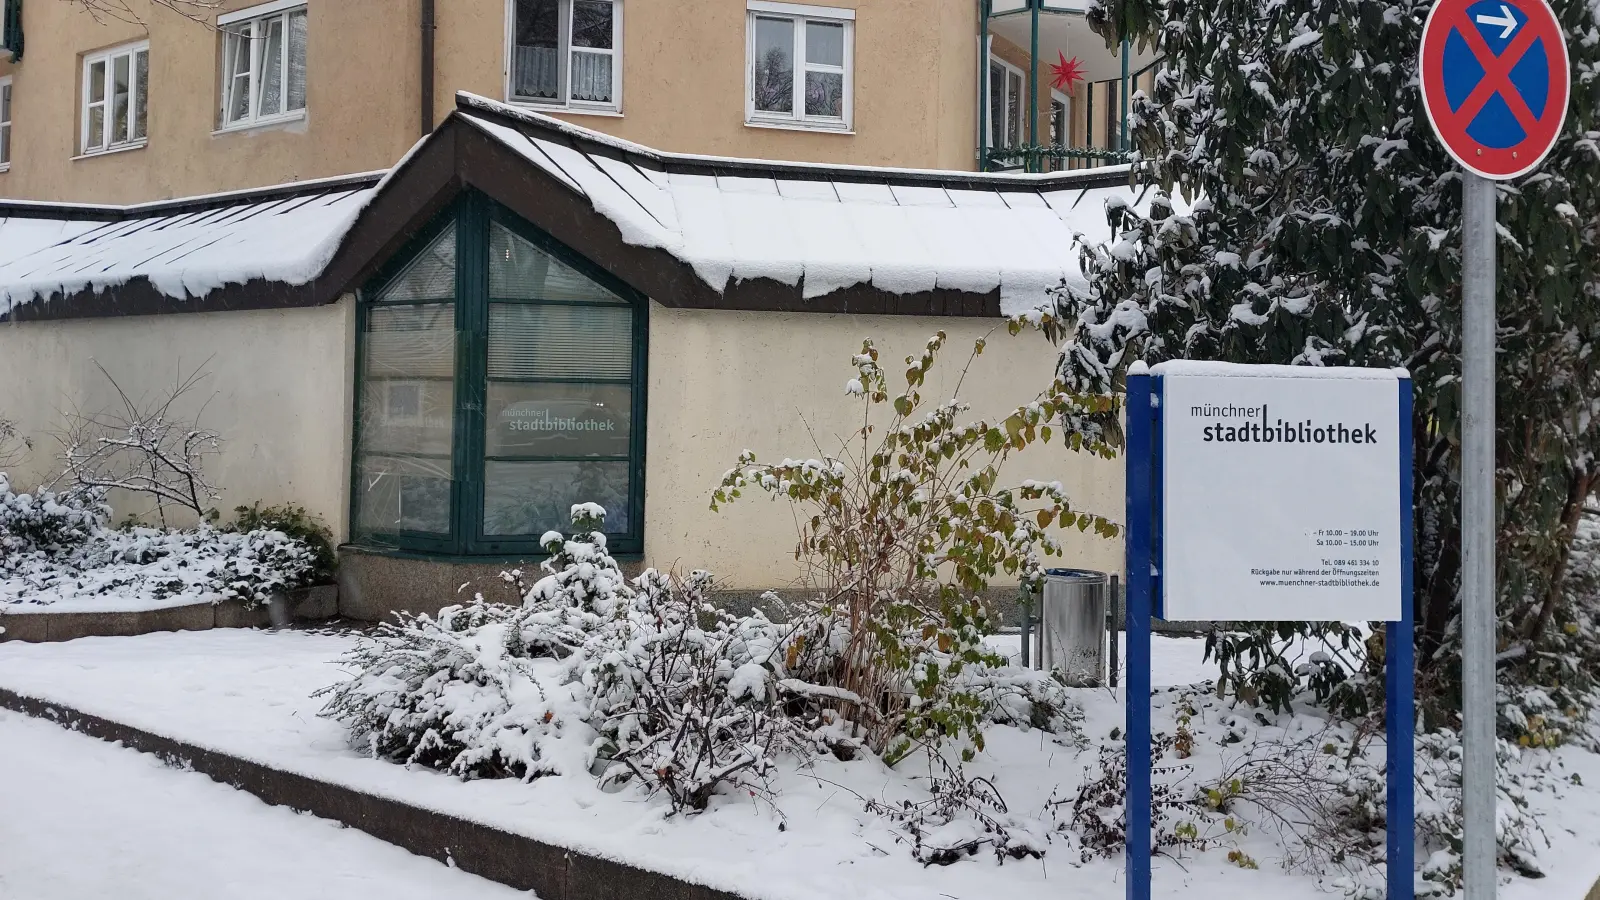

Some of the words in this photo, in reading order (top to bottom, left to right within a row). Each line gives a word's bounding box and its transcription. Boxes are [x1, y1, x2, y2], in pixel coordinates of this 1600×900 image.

[502, 408, 545, 417] münchner
[1191, 403, 1261, 418] münchner
[509, 408, 615, 431] stadtbibliothek
[1203, 404, 1378, 444] stadtbibliothek
[1251, 568, 1280, 577] Rückgabe
[1294, 568, 1320, 576] während
[1332, 567, 1379, 577] Öffnungszeiten
[1260, 579, 1380, 587] www.muenchner-stadtbibliothek.de
